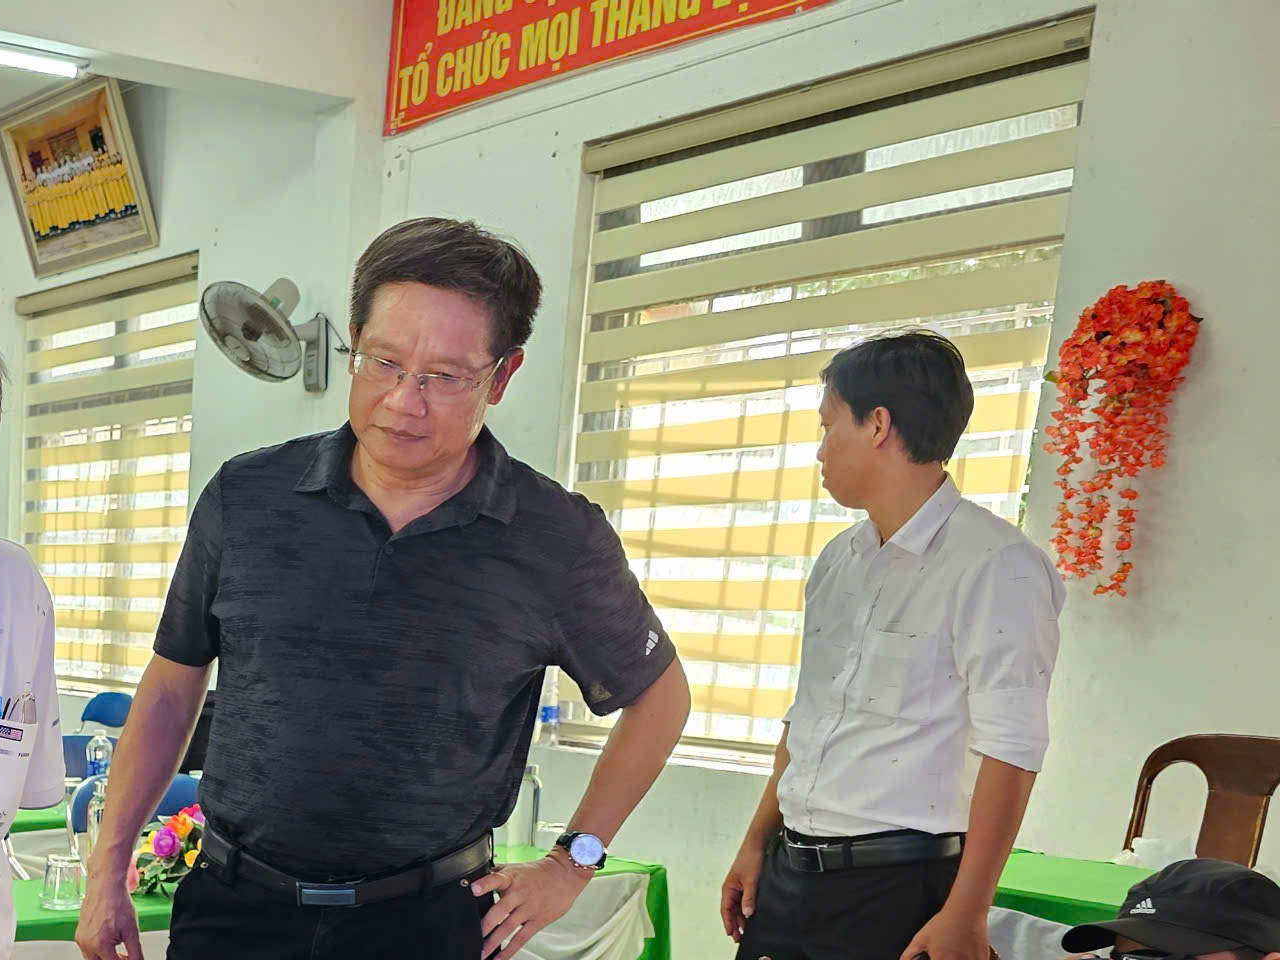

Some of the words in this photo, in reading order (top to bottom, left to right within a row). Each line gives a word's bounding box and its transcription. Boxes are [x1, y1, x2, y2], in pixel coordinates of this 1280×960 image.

[399, 42, 433, 110] TỔ
[436, 29, 511, 97] CHỨC
[518, 7, 581, 71] MỌI
